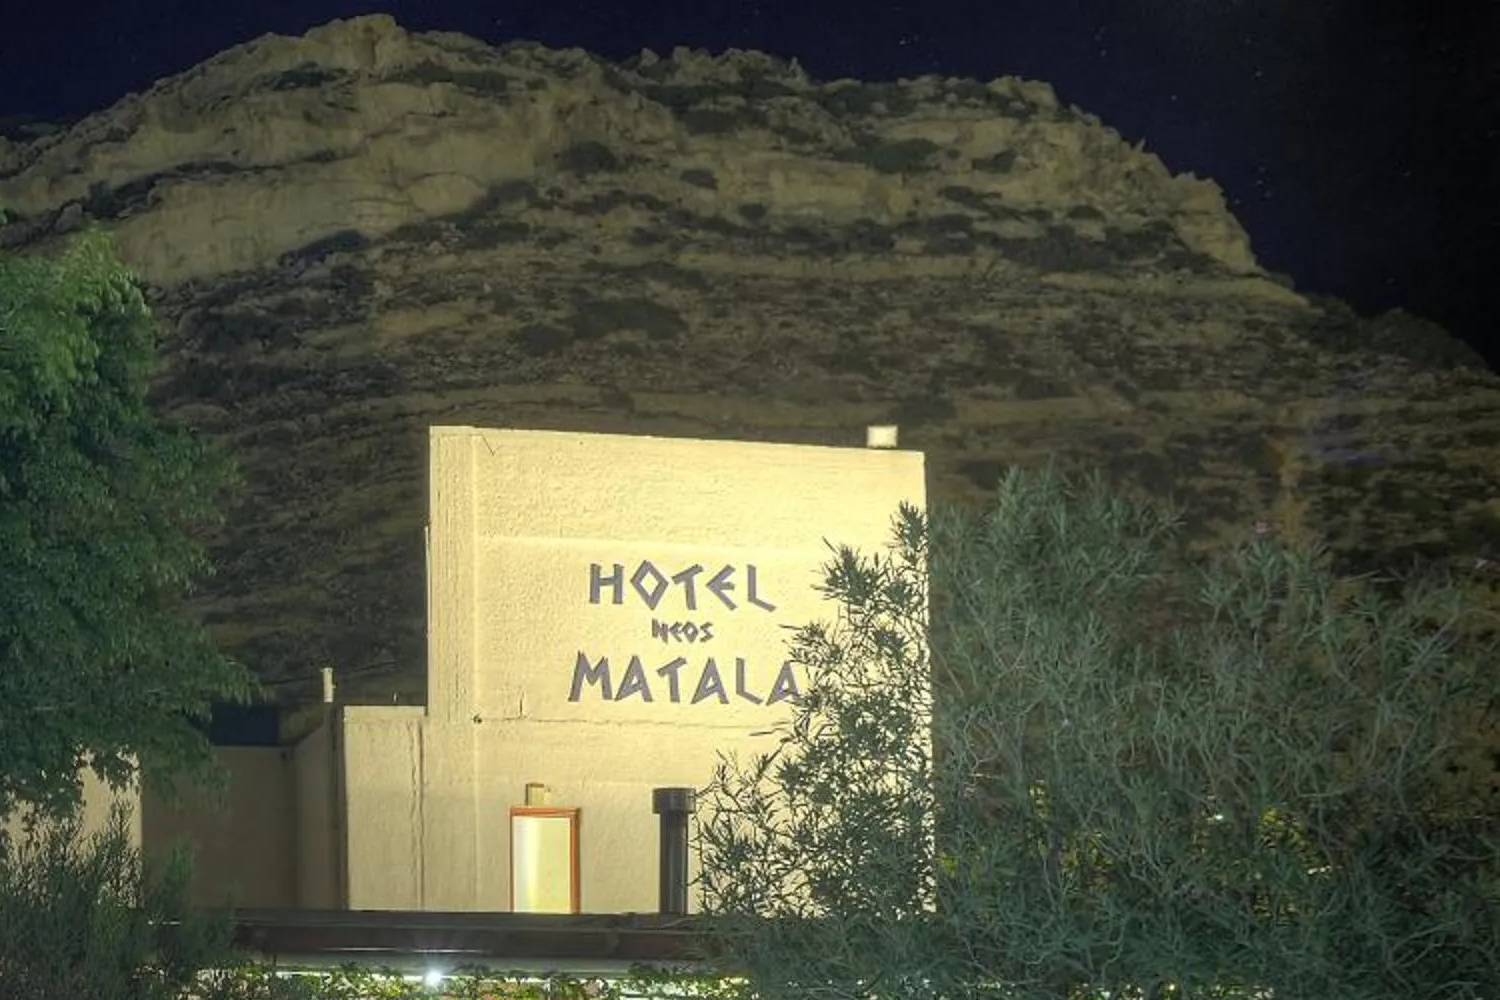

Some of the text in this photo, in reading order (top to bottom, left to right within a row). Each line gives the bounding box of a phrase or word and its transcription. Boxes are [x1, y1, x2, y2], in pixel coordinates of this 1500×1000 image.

[589, 560, 776, 611] HOTEL
[651, 618, 714, 644] NEOS
[568, 651, 802, 705] MATALA
